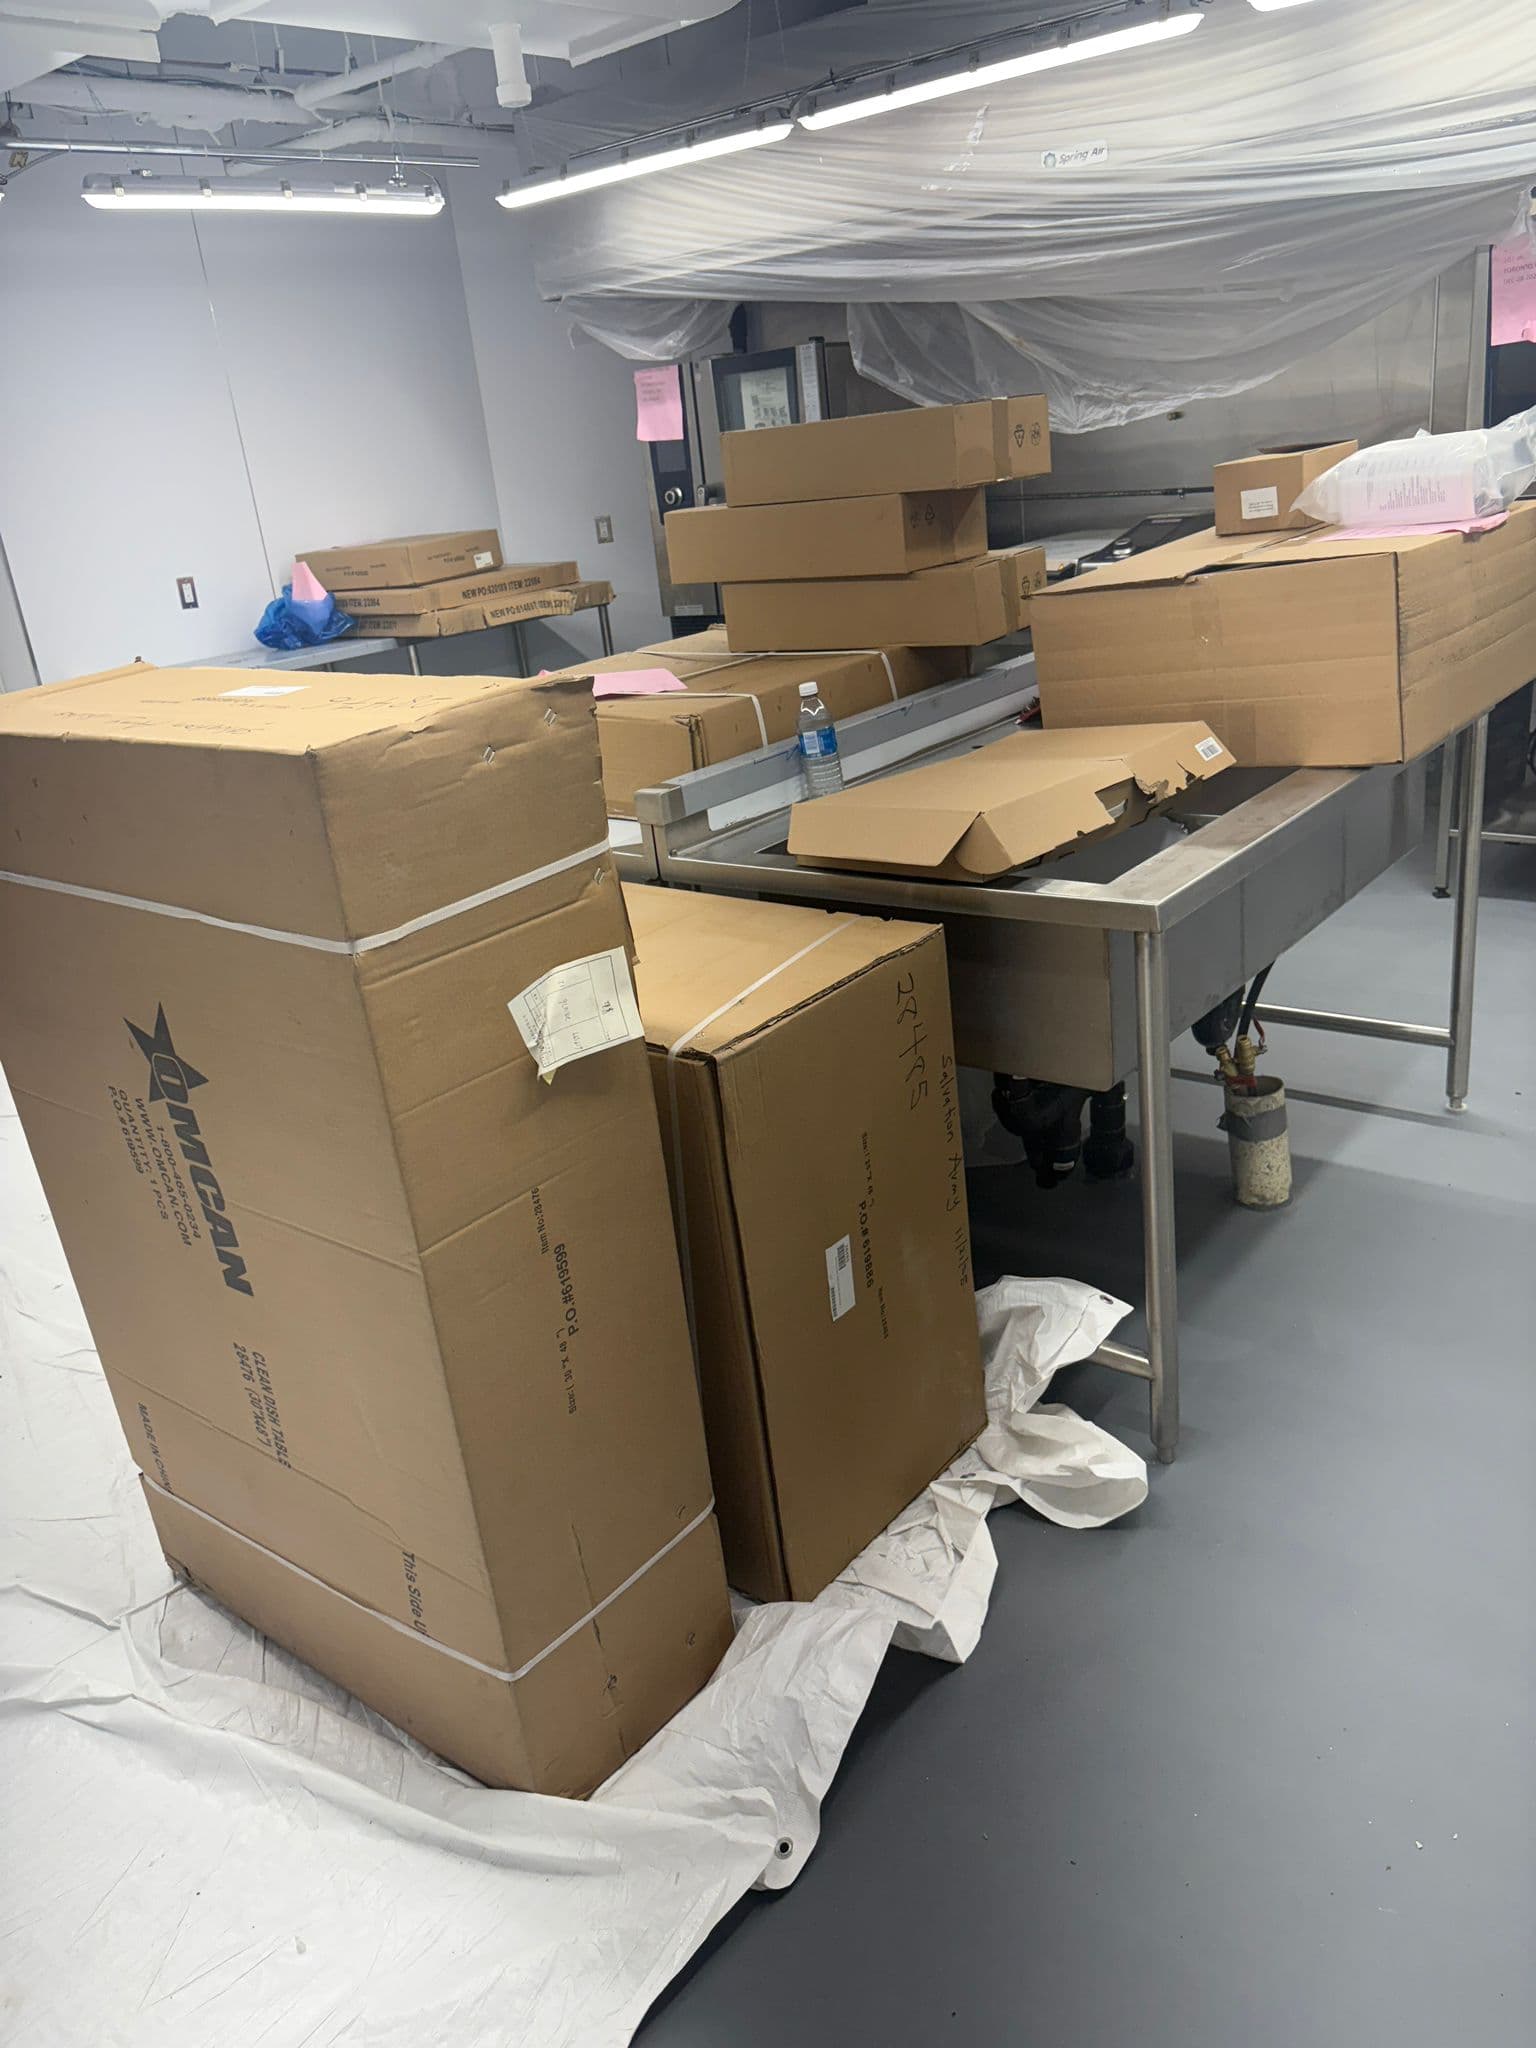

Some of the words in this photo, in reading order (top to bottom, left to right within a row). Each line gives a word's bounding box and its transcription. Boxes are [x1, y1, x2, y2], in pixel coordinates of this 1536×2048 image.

[1059, 149, 1089, 165] Spring
[1091, 147, 1105, 157] Air
[940, 1054, 955, 1144] Salvation
[135, 1098, 192, 1247] WWW.OMCAN.COM
[152, 1052, 255, 1298] OMCAN
[157, 1125, 202, 1239] 1-800-465-0234
[153, 1188, 169, 1221] PCS
[233, 1341, 255, 1383] 28476
[252, 1351, 273, 1395] CLEAN
[138, 1401, 157, 1443] MADE
[150, 1441, 161, 1458] IN
[263, 1393, 281, 1427] DISH
[271, 1425, 292, 1470] TABLE
[402, 1551, 417, 1583] This
[408, 1585, 423, 1618] Side
